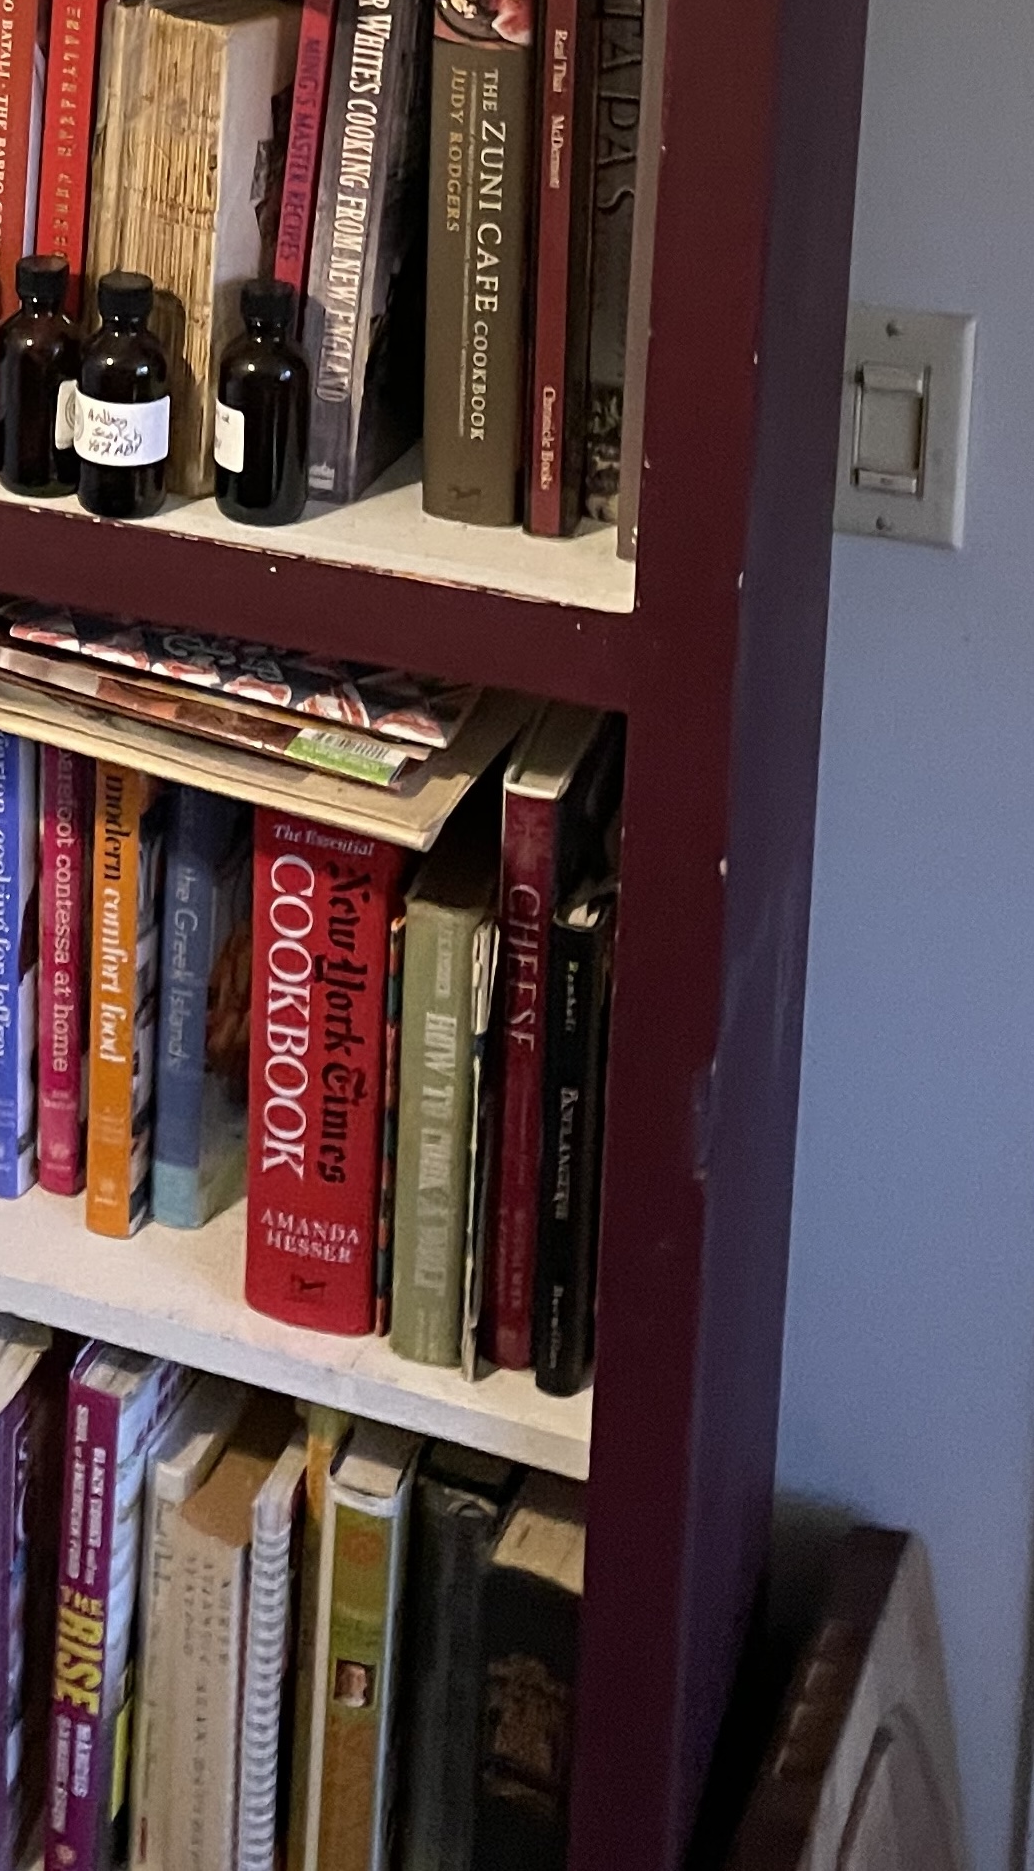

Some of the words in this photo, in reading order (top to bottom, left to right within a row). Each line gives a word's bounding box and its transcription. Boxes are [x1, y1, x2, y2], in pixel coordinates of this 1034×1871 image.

[0, 19, 13, 79] BATALI
[552, 60, 566, 93] Thai
[554, 29, 568, 59] Real
[450, 67, 467, 124] JUDY
[483, 68, 499, 112] THE
[339, 99, 378, 190] COOKING
[478, 121, 506, 211] ZUNI
[446, 131, 463, 232] RODGERS
[279, 192, 307, 261] RECIPES
[332, 192, 367, 252] FROM
[327, 255, 362, 306] NEW
[475, 222, 503, 312] CAFE
[317, 307, 355, 402] ENGLAND
[470, 320, 489, 441] COOKBOOK
[541, 449, 554, 491] Books
[104, 774, 132, 881] modern
[274, 824, 302, 844] The
[305, 829, 376, 857] Essential
[55, 854, 74, 966] contessa
[175, 867, 196, 901] the
[326, 861, 372, 953] New
[101, 887, 128, 994] comfort
[174, 909, 198, 982] Greek
[506, 883, 541, 1052] CHEESE
[55, 970, 71, 997] at
[262, 853, 315, 1180] COOKBOOK
[314, 954, 368, 1056] York
[53, 1002, 74, 1073] home
[99, 1003, 126, 1063] food
[168, 989, 194, 1069] Islands
[424, 1012, 457, 1078] HOW
[317, 1062, 368, 1184] Times
[261, 1208, 360, 1245] AMANDA
[267, 1231, 352, 1265] HESSER
[61, 1585, 103, 1616] THE
[54, 1609, 104, 1715] RISE
